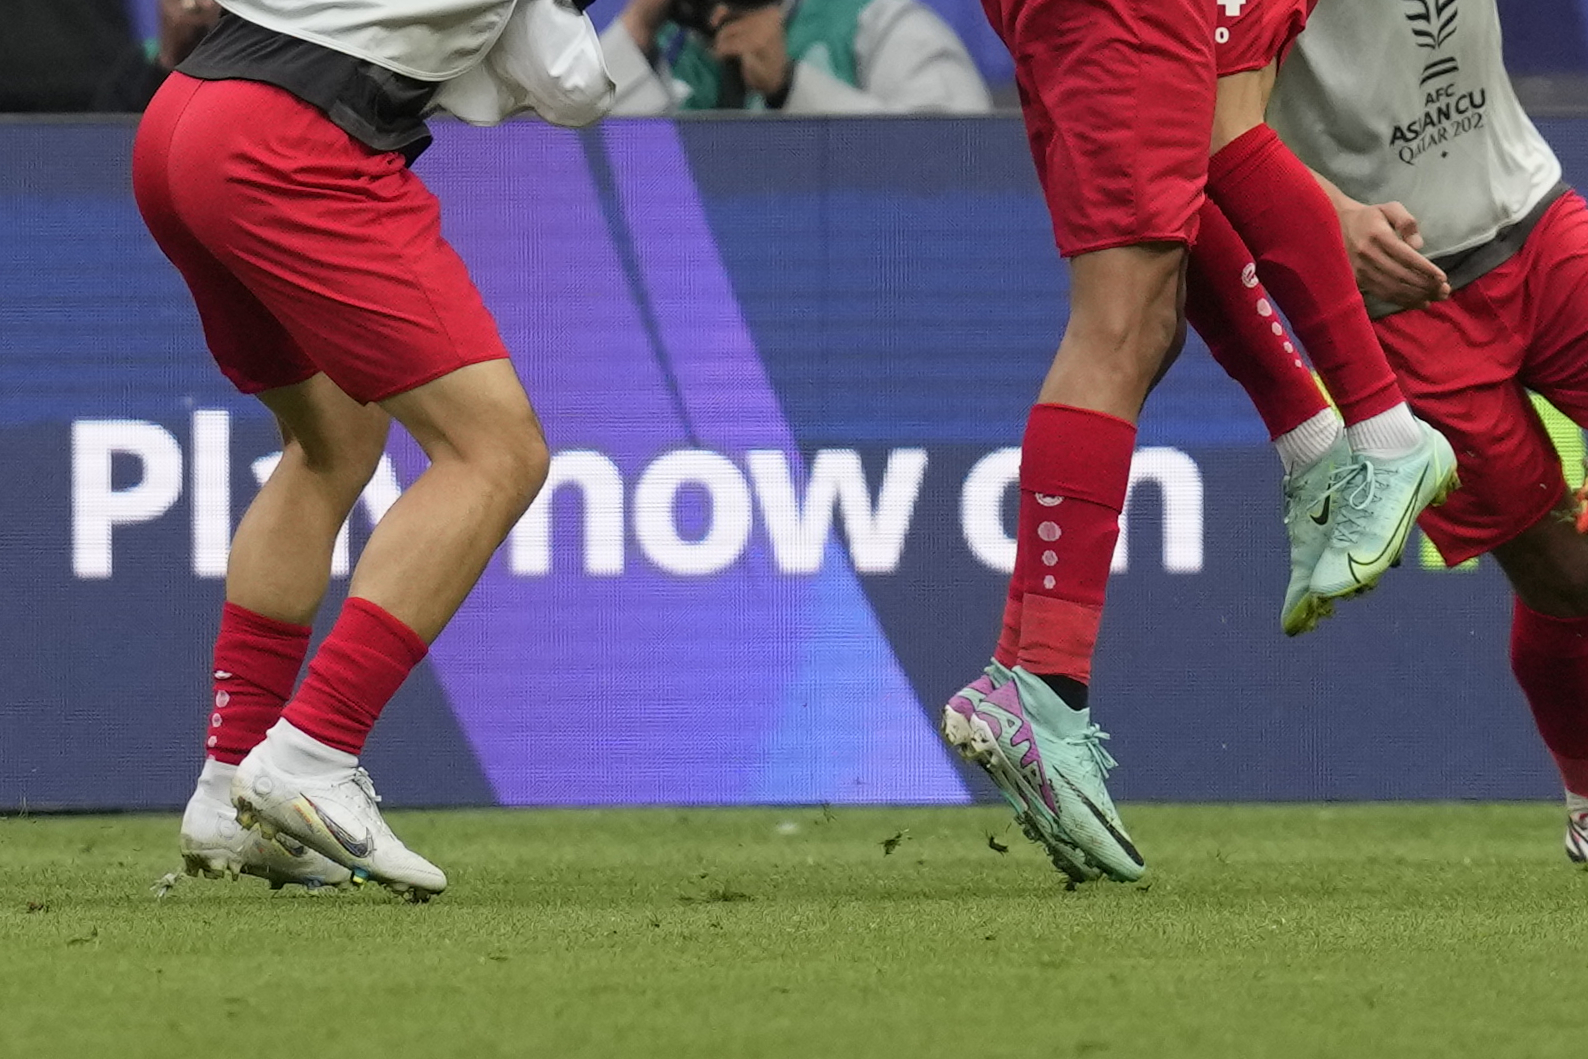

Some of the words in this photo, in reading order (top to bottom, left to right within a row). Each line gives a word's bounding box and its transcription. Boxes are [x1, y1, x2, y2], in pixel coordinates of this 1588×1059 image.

[1424, 83, 1456, 107] AFC
[1455, 87, 1486, 114] CU
[1451, 111, 1485, 138] 202
[70, 409, 403, 579] Pl
[510, 446, 929, 579] now
